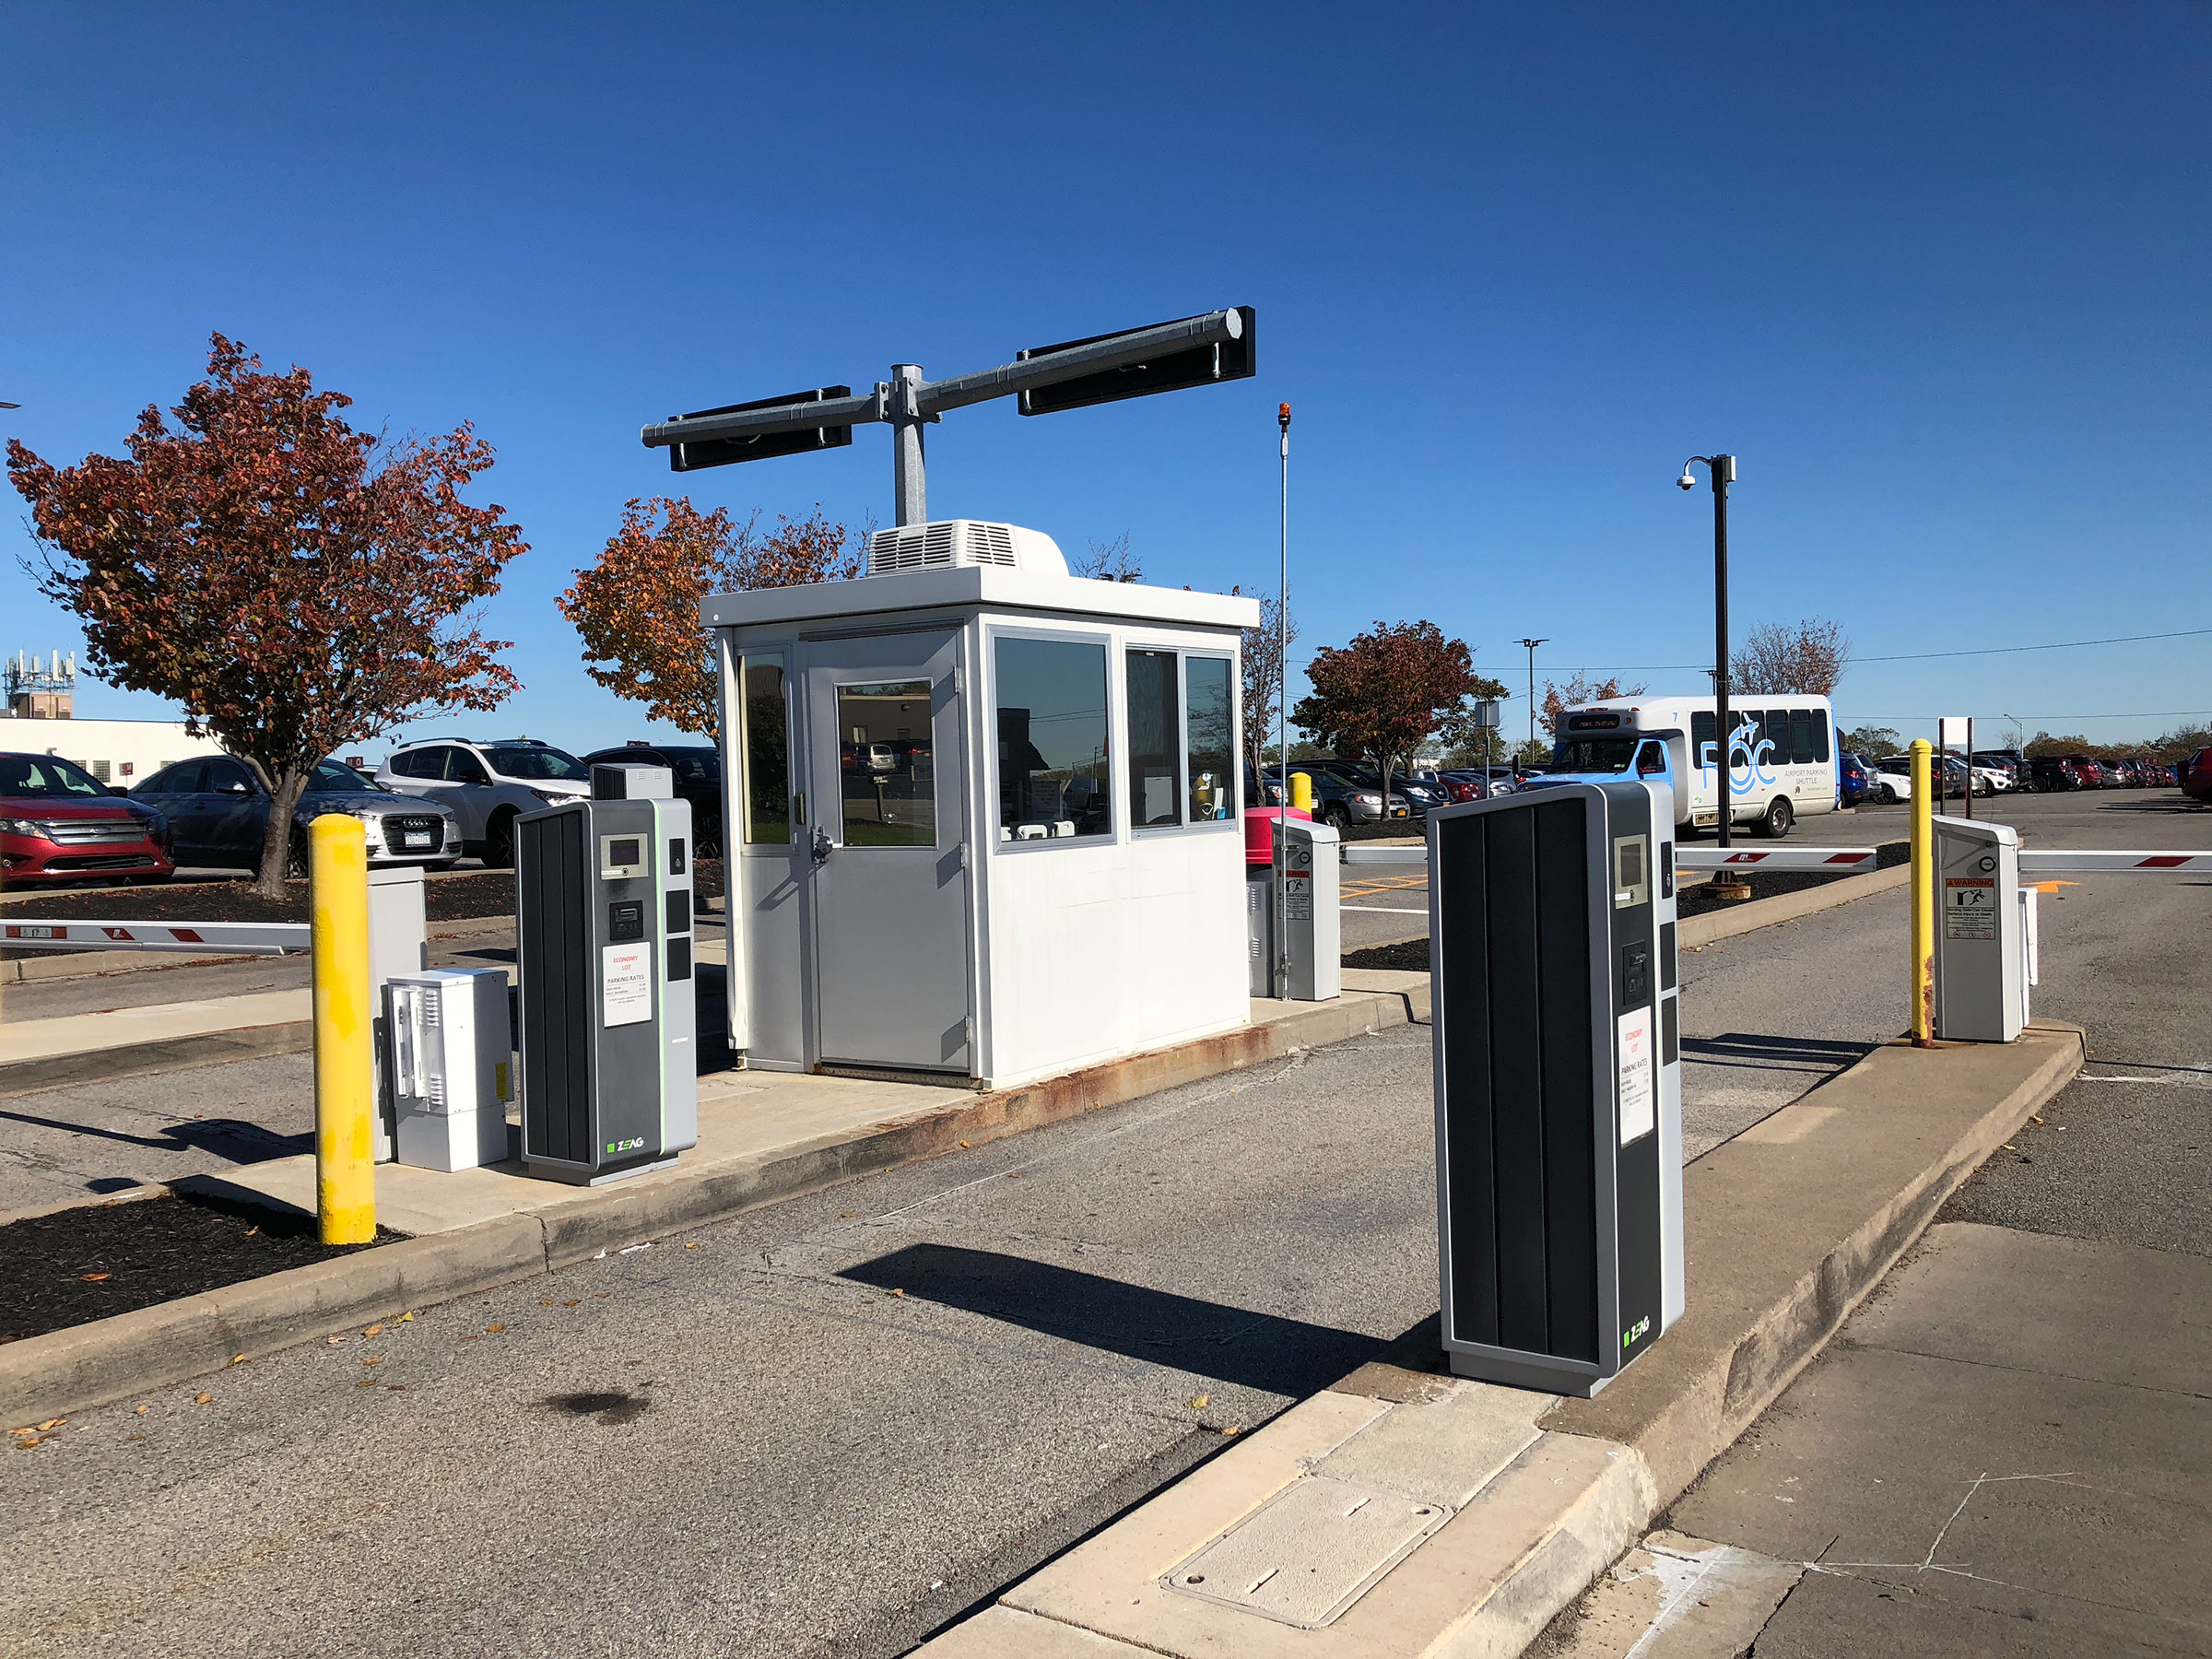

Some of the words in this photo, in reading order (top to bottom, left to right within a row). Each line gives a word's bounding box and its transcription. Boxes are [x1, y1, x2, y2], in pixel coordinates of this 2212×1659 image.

[1672, 712, 1678, 723] 7
[1625, 1029, 1642, 1041] ECONOMY
[1621, 1062, 1636, 1074] PARKING
[1637, 1058, 1648, 1068] RATES
[617, 1136, 644, 1152] ZEAG
[1630, 1314, 1650, 1343] ZEAG
